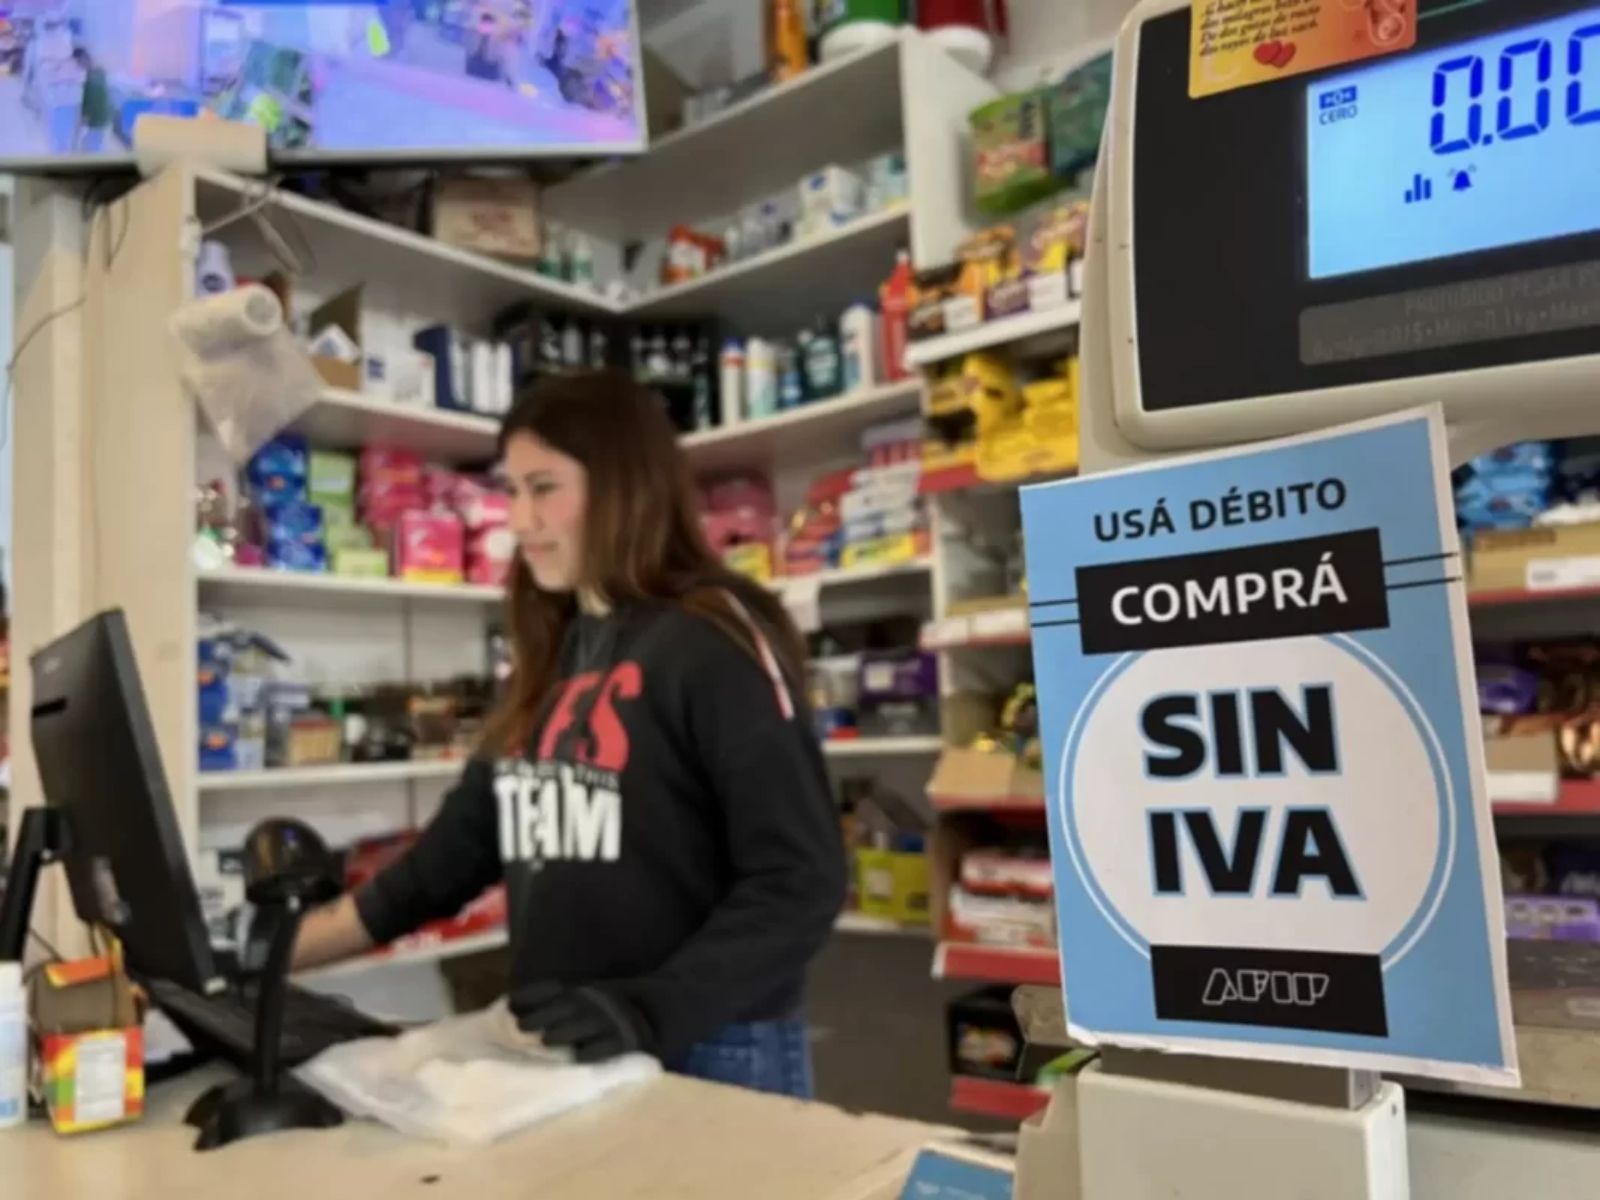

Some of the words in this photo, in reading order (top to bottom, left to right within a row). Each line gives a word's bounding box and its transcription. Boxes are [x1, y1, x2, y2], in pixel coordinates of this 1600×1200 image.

[1319, 104, 1358, 126] CERO
[1094, 497, 1176, 543] USÁ
[1189, 477, 1347, 531] DÉBITO
[1111, 551, 1348, 626] COMPRÁ
[1139, 682, 1341, 782] SIN
[493, 763, 622, 864] TEAM
[1146, 804, 1366, 900] IVA
[1202, 967, 1330, 1006] AFIP
